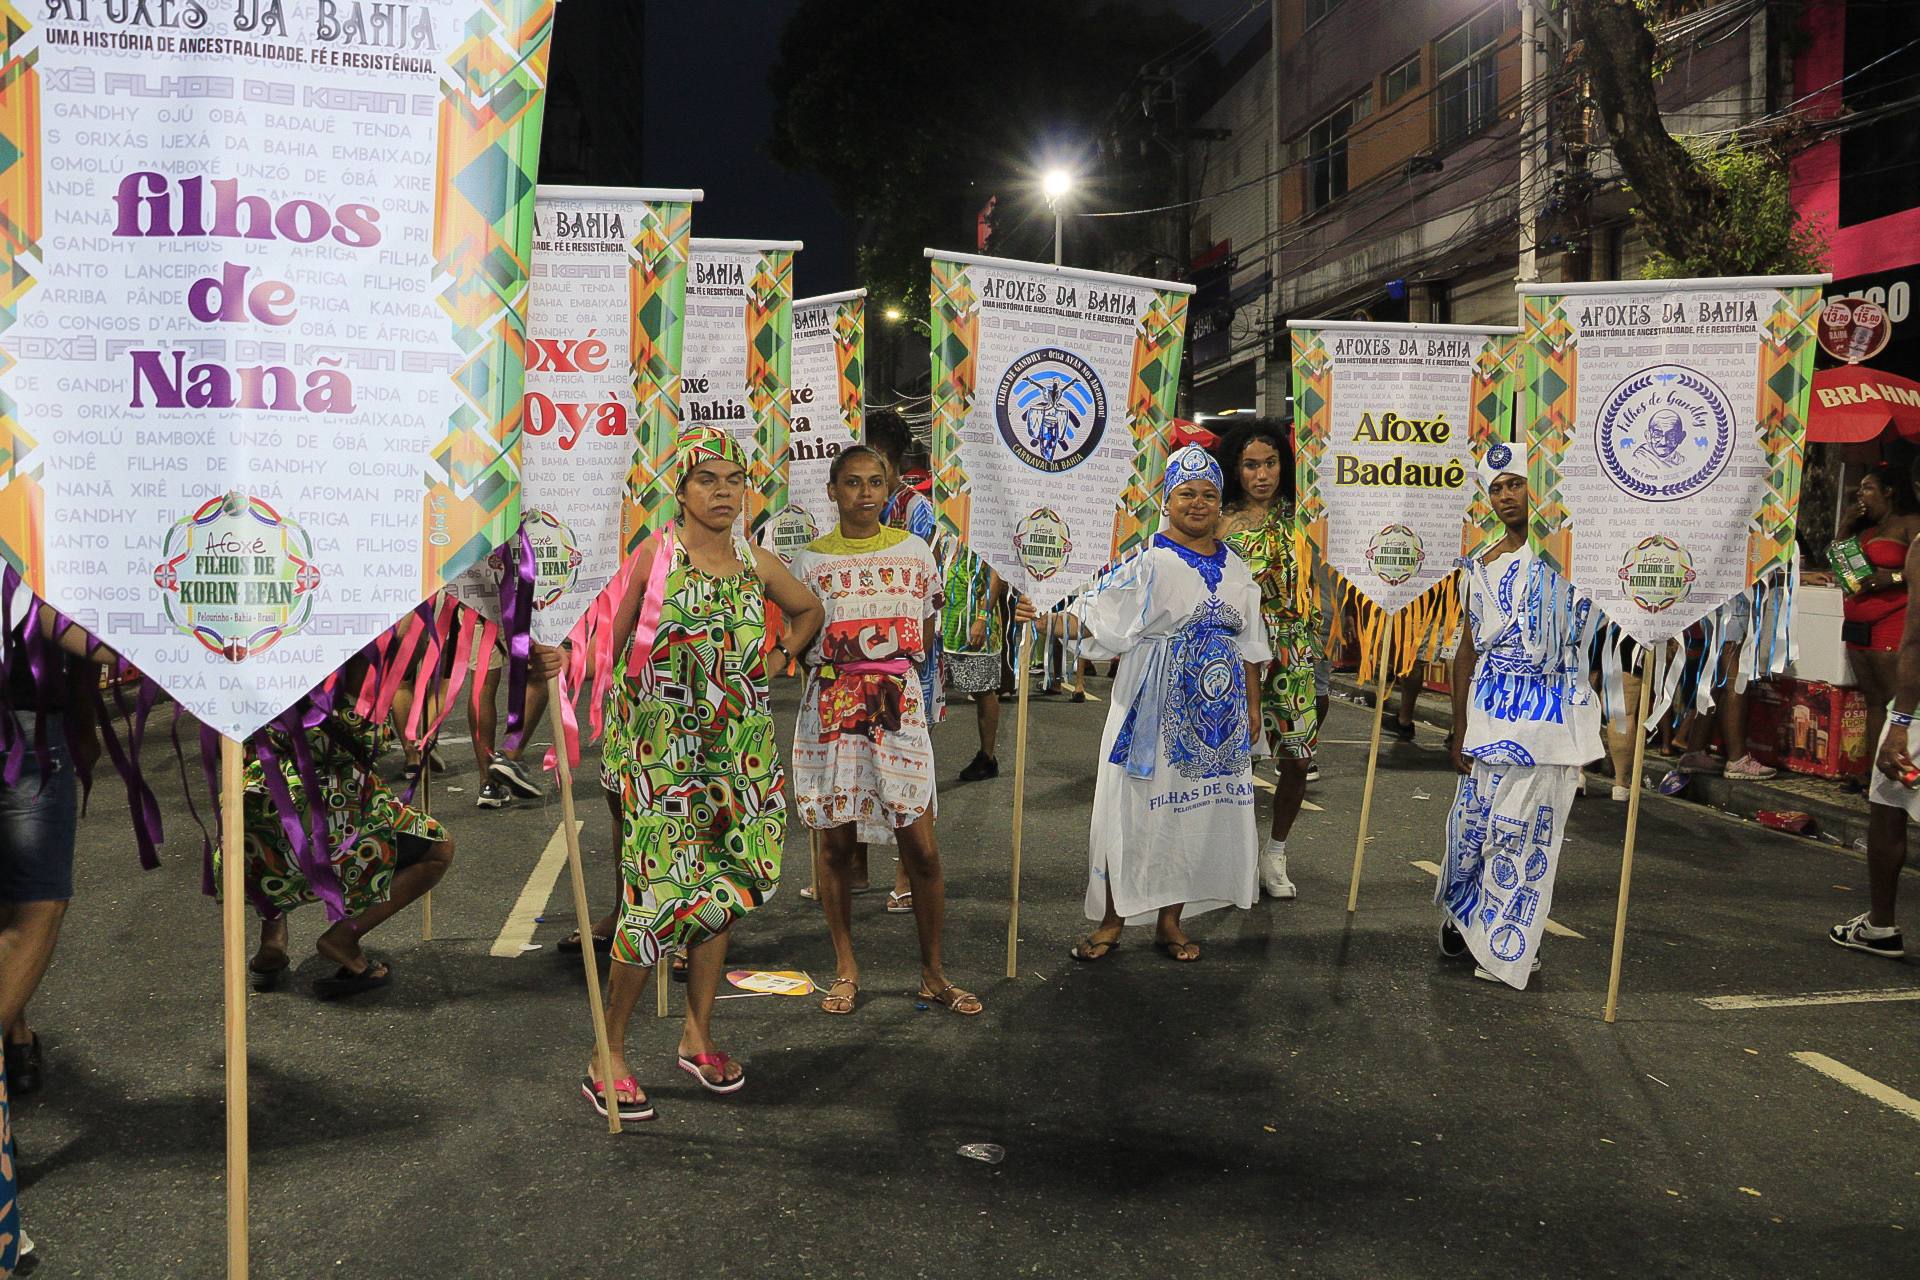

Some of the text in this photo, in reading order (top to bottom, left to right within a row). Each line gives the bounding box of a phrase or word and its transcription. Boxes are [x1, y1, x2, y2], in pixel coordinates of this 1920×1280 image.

[316, 0, 436, 50] BAHIA
[46, 28, 79, 46] UMA
[84, 31, 152, 51] HISTÓRIA
[157, 37, 175, 53] DE
[179, 38, 307, 63] ANCESTRALIDADE.
[311, 46, 327, 65] FÉ
[331, 51, 339, 66] E
[342, 52, 437, 74] RESISTÊNCIA.
[54, 102, 412, 139] GANDHY OJÚ OBÁ BADAUÊ TENDA
[75, 128, 148, 148] ORIXÁS
[225, 136, 249, 151] DA
[264, 139, 319, 158] BAHIA
[51, 155, 123, 173] OMOLÚ
[236, 163, 290, 180] UNZÓ
[305, 168, 327, 184] DE
[112, 172, 381, 247] filhos
[556, 212, 625, 239] BAHIA
[555, 240, 564, 251] FÉ
[565, 242, 571, 251] E
[363, 275, 425, 291] FILHOS
[696, 263, 744, 285] BAHIA
[40, 289, 107, 304] ARRIBA
[188, 262, 297, 326] de
[1056, 286, 1077, 308] DA
[1088, 290, 1137, 316] BAHIA
[982, 300, 996, 309] UMA
[1024, 304, 1032, 313] DE
[1662, 302, 1686, 323] DA
[1700, 301, 1758, 323] BAHIA
[59, 316, 140, 330] CONGOS
[794, 309, 829, 330] BAHIA
[1580, 329, 1595, 338] UMA
[1595, 327, 1626, 338] HISTÓRIA
[1627, 328, 1636, 336] DE
[1696, 324, 1705, 334] FÉ
[1705, 325, 1711, 334] E
[1399, 339, 1418, 356] DA
[1427, 340, 1471, 358] BAHIA
[130, 351, 357, 414] Nanã
[997, 382, 1011, 406] FILHAS
[1006, 371, 1015, 382] DE
[1014, 352, 1041, 373] GANDHY
[691, 399, 746, 421] Bahia
[1616, 390, 1708, 433] Filhos de Gandhy
[53, 428, 319, 448] OMOLÚ BAMBOXÉ UNZÓ DE
[1353, 412, 1450, 444] Afoxé
[128, 456, 327, 474] FILHAS DE GANDHY
[1012, 444, 1084, 472] CARNAVAL DA BAHIA
[1336, 455, 1464, 487] Badauê
[300, 487, 379, 502] AFOMAN
[55, 509, 136, 523] GANDHY
[205, 532, 266, 558] Afoxé
[357, 539, 417, 553] FILHOS
[195, 556, 275, 575] FILHOS DE
[542, 561, 568, 576] EFAN
[1637, 564, 1675, 574] FILHOS DE
[1629, 575, 1683, 588] KORIN EFAN
[180, 581, 293, 605] KORIN EFAN
[256, 645, 324, 664] BADAUÊ
[257, 677, 308, 690] BAHIA
[1149, 788, 1199, 811] FILHAS
[1203, 782, 1222, 797] DE
